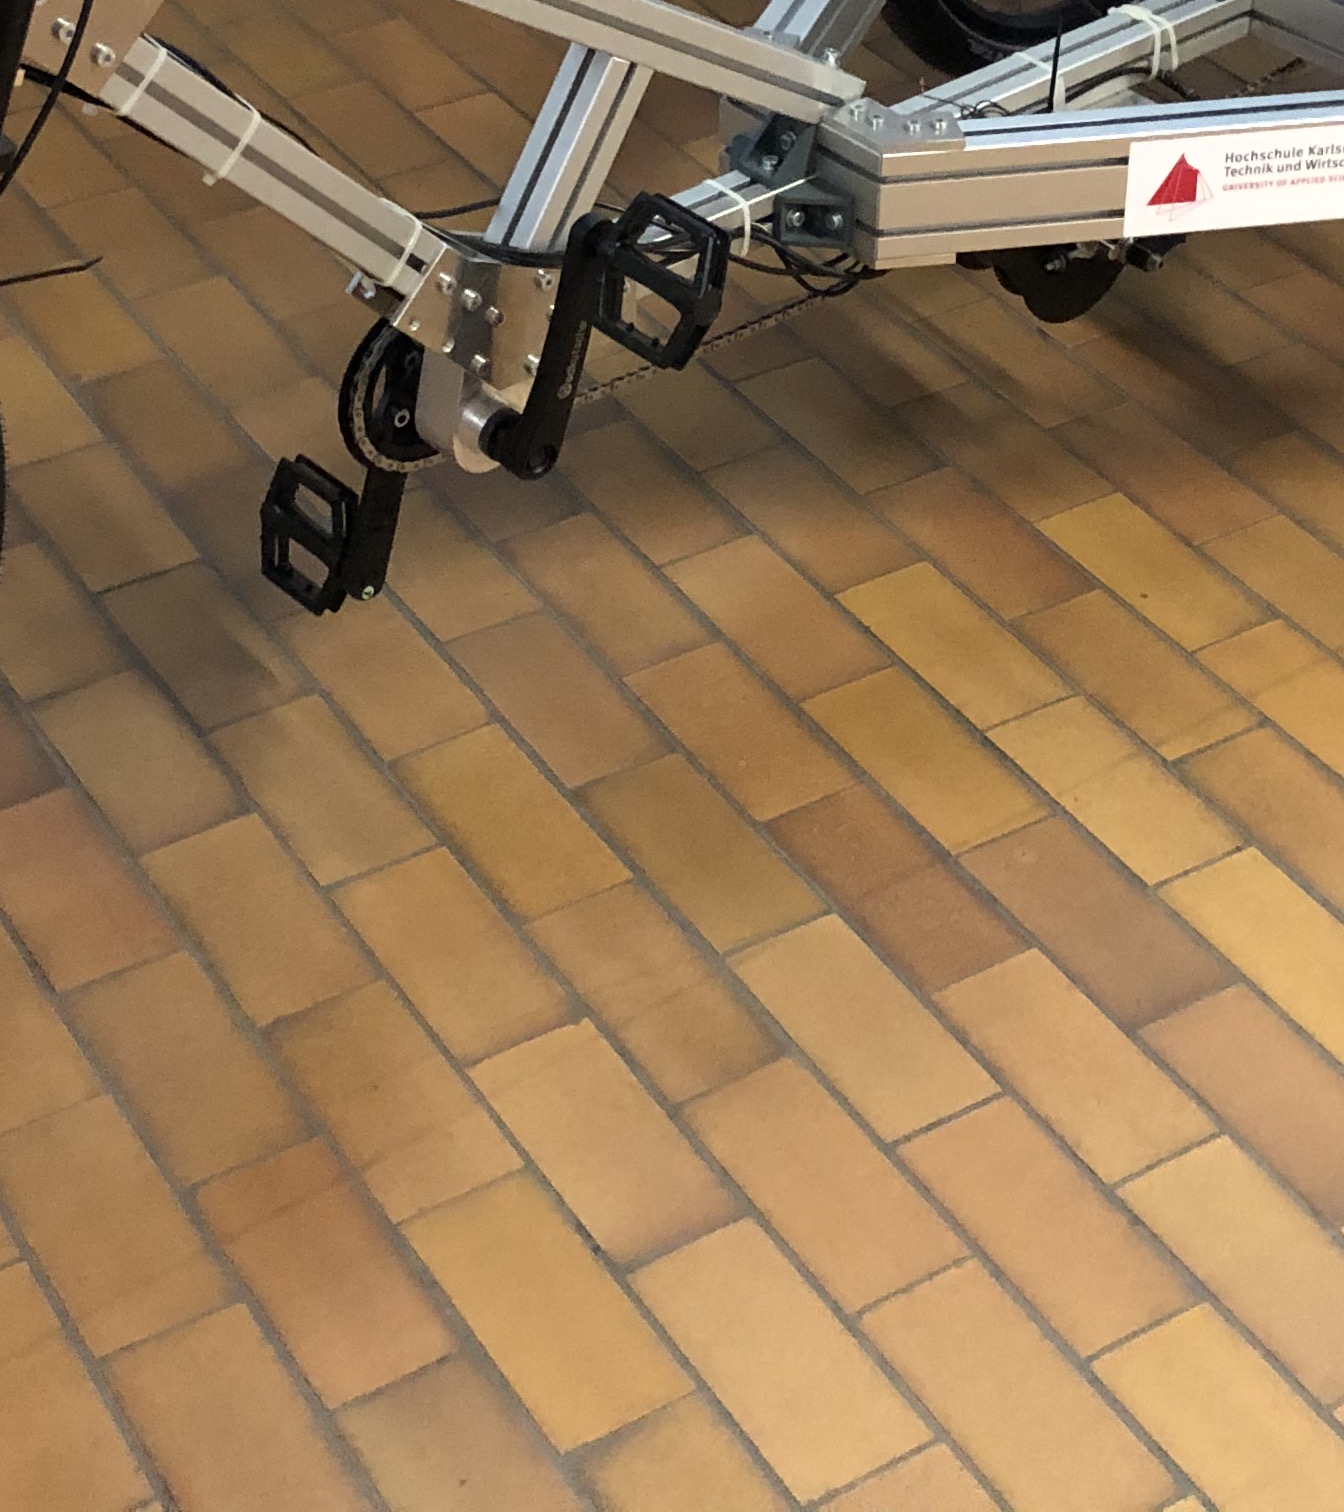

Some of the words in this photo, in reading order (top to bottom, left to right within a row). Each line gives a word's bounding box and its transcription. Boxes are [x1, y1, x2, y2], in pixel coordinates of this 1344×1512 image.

[1224, 147, 1304, 164] Hochschule
[1224, 163, 1277, 178] Technik
[1277, 161, 1302, 173] und
[1222, 179, 1273, 191] UNIVERSITY
[1276, 178, 1287, 187] OF
[1290, 175, 1326, 186] APPLIED
